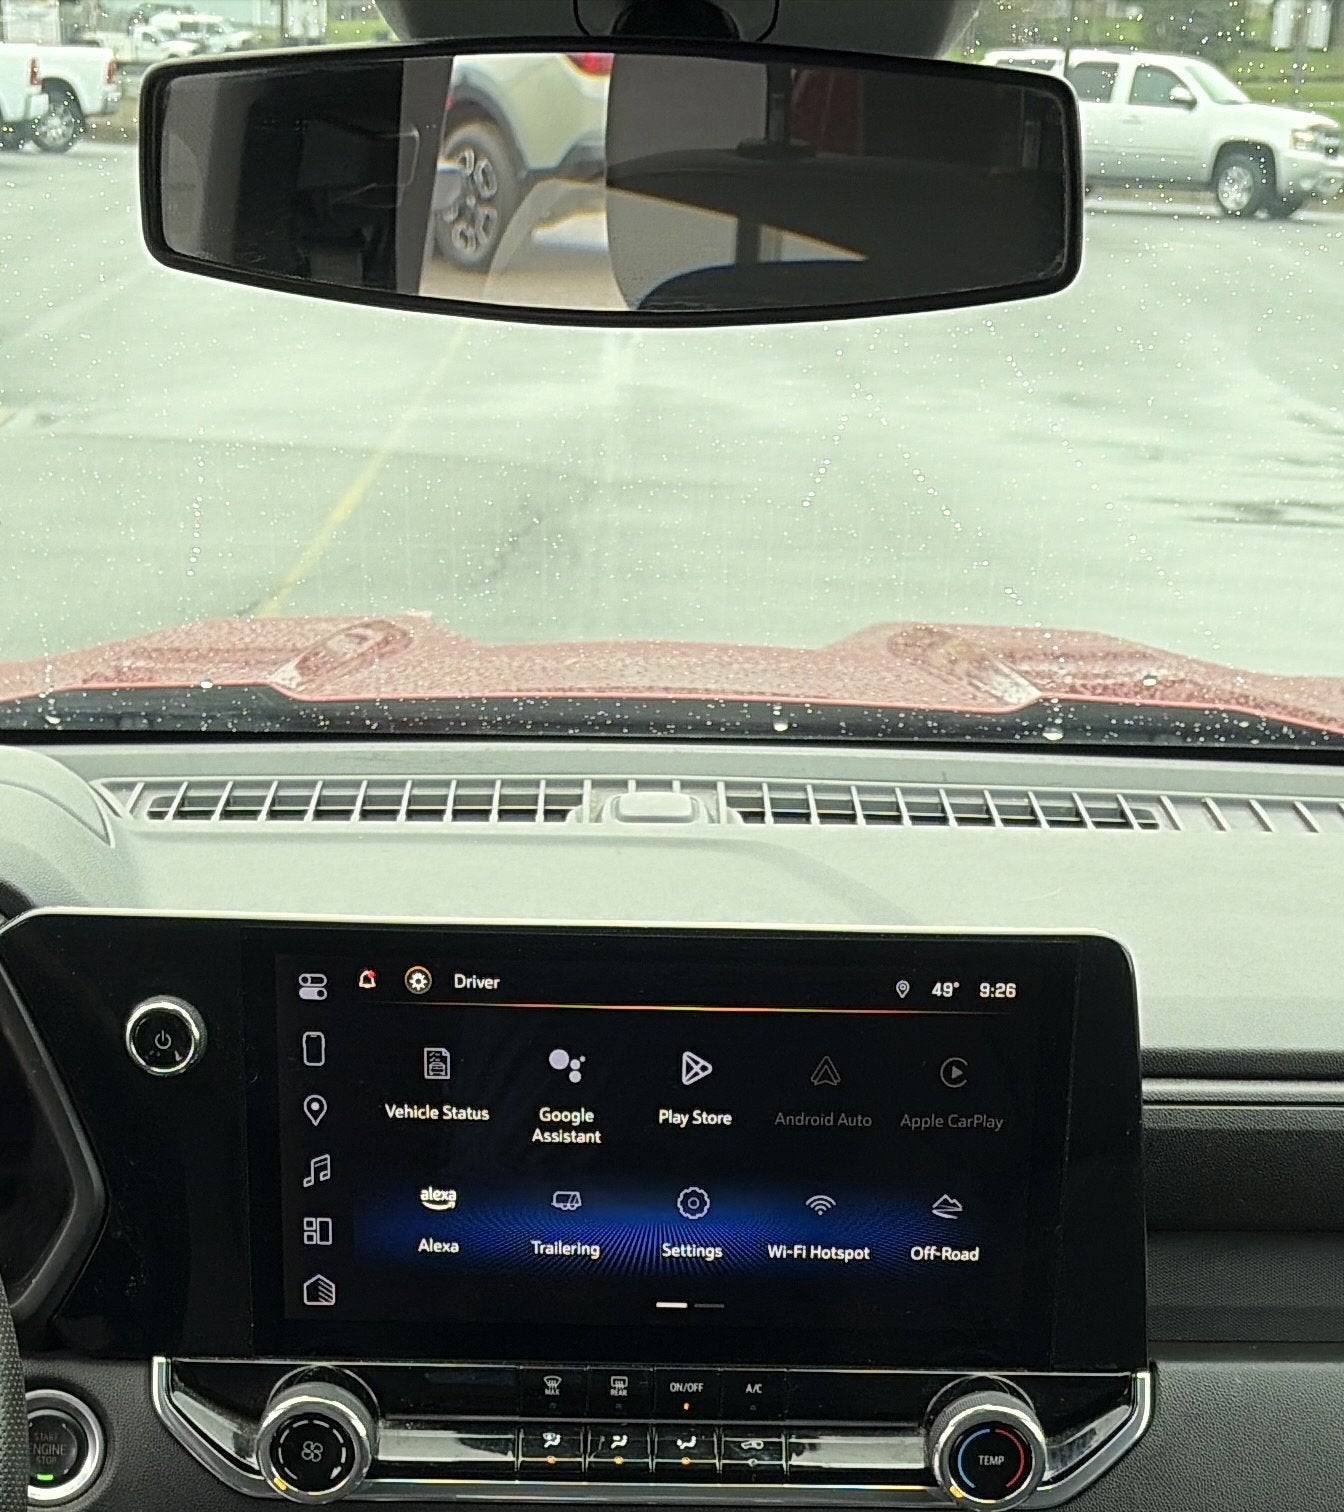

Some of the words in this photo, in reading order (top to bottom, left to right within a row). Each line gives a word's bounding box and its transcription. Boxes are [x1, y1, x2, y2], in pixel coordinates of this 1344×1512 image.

[454, 973, 500, 990] Driver
[932, 981, 960, 998] 49°
[979, 983, 1017, 998] 9:26
[385, 1104, 439, 1121] Vehicle
[442, 1105, 490, 1121] Status
[539, 1107, 595, 1126] Google
[659, 1110, 689, 1128] Play
[692, 1110, 732, 1126] Store
[775, 1112, 834, 1128] Android
[838, 1113, 873, 1128] Auto
[900, 1114, 944, 1131] Apple
[947, 1114, 1004, 1131] CarPlay
[532, 1129, 602, 1144] Assistant
[421, 1186, 457, 1202] alexa
[418, 1238, 459, 1253] Alexa
[531, 1240, 601, 1259] Trailering
[662, 1243, 723, 1262] Settings
[768, 1244, 807, 1260] Wi-Fi
[810, 1245, 870, 1262] Hotspot
[910, 1246, 980, 1262] Off-Road
[670, 1382, 704, 1394] ON/OFF
[745, 1383, 763, 1394] A/C
[978, 1454, 1005, 1466] TEMP
